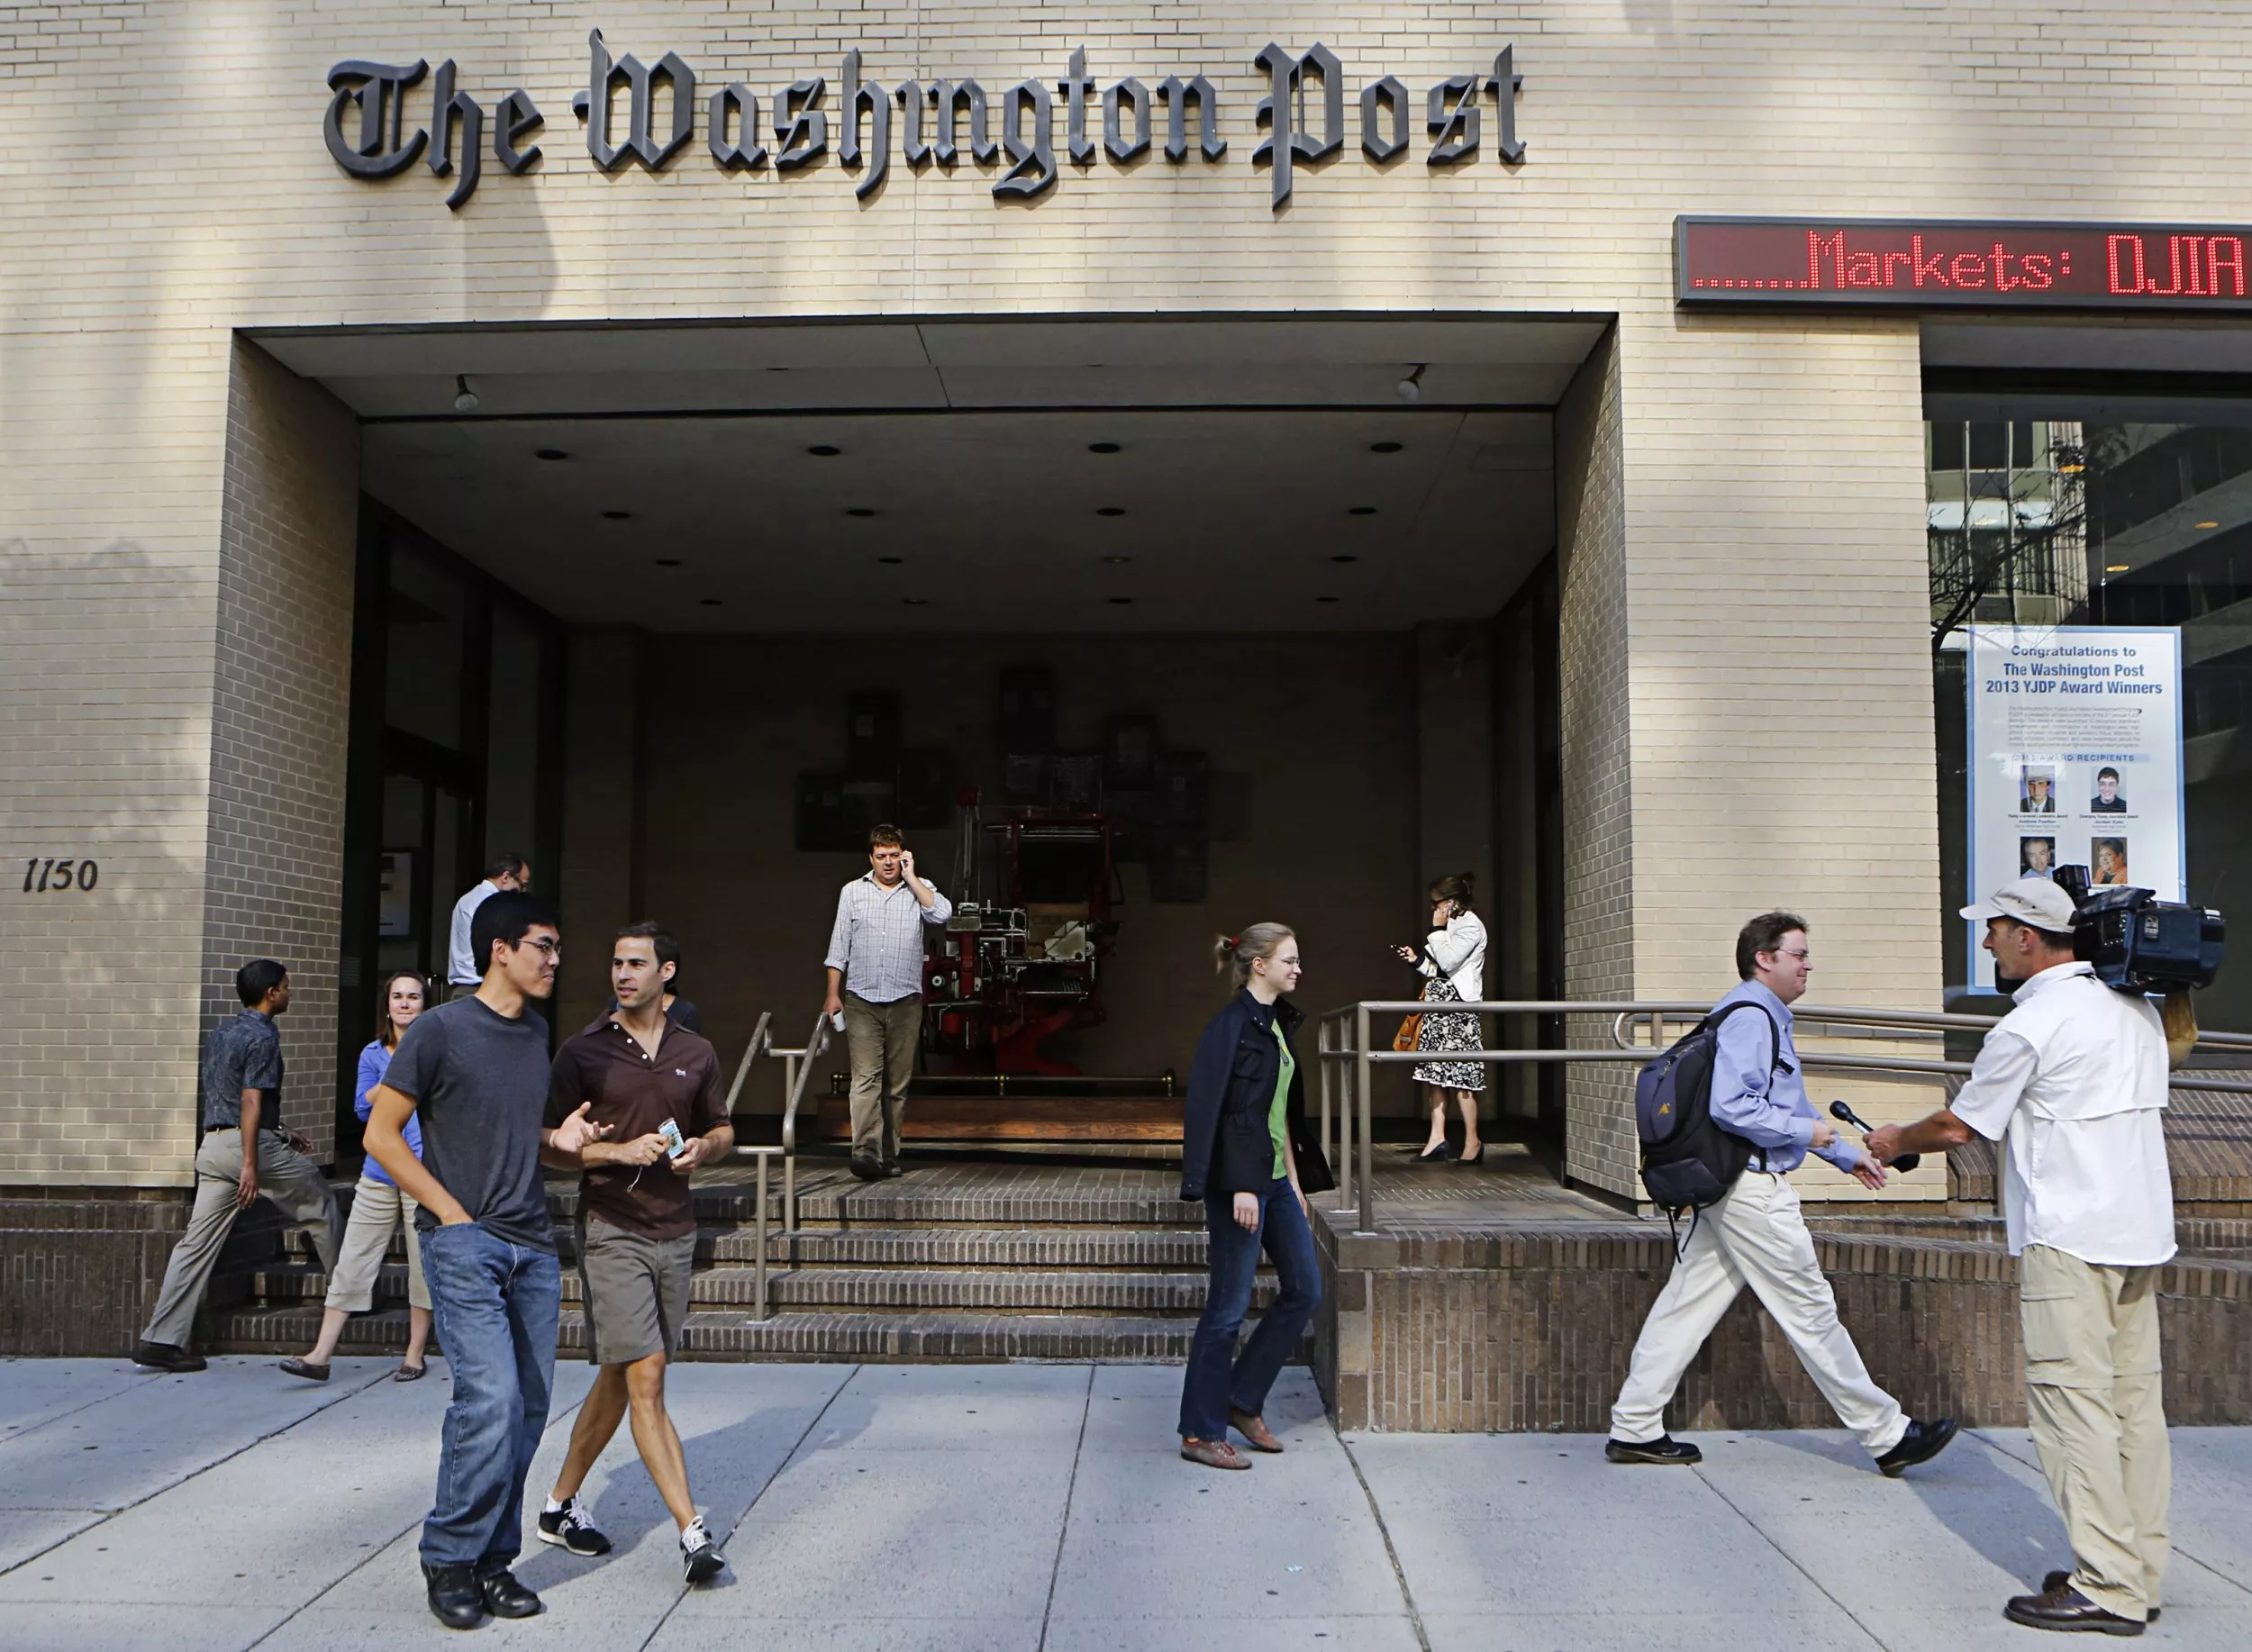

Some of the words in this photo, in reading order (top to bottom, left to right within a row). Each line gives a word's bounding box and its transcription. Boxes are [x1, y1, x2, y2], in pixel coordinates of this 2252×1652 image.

[323, 58, 544, 211] The
[572, 27, 1227, 201] Washington
[1251, 41, 1525, 212] Post
[2108, 234, 2246, 295] DJIA
[2011, 645, 2118, 658] Congratulations
[2123, 646, 2137, 658] to
[2004, 663, 2027, 676] The
[2030, 664, 2110, 679] Washington
[2114, 665, 2144, 677] Post
[1986, 680, 2020, 694] 2013
[2024, 681, 2057, 694] YJDP
[2060, 682, 2103, 694] Award
[2107, 682, 2163, 694] Winners
[2077, 754, 2135, 762] RECIPIENTS
[23, 858, 98, 893] 1150
